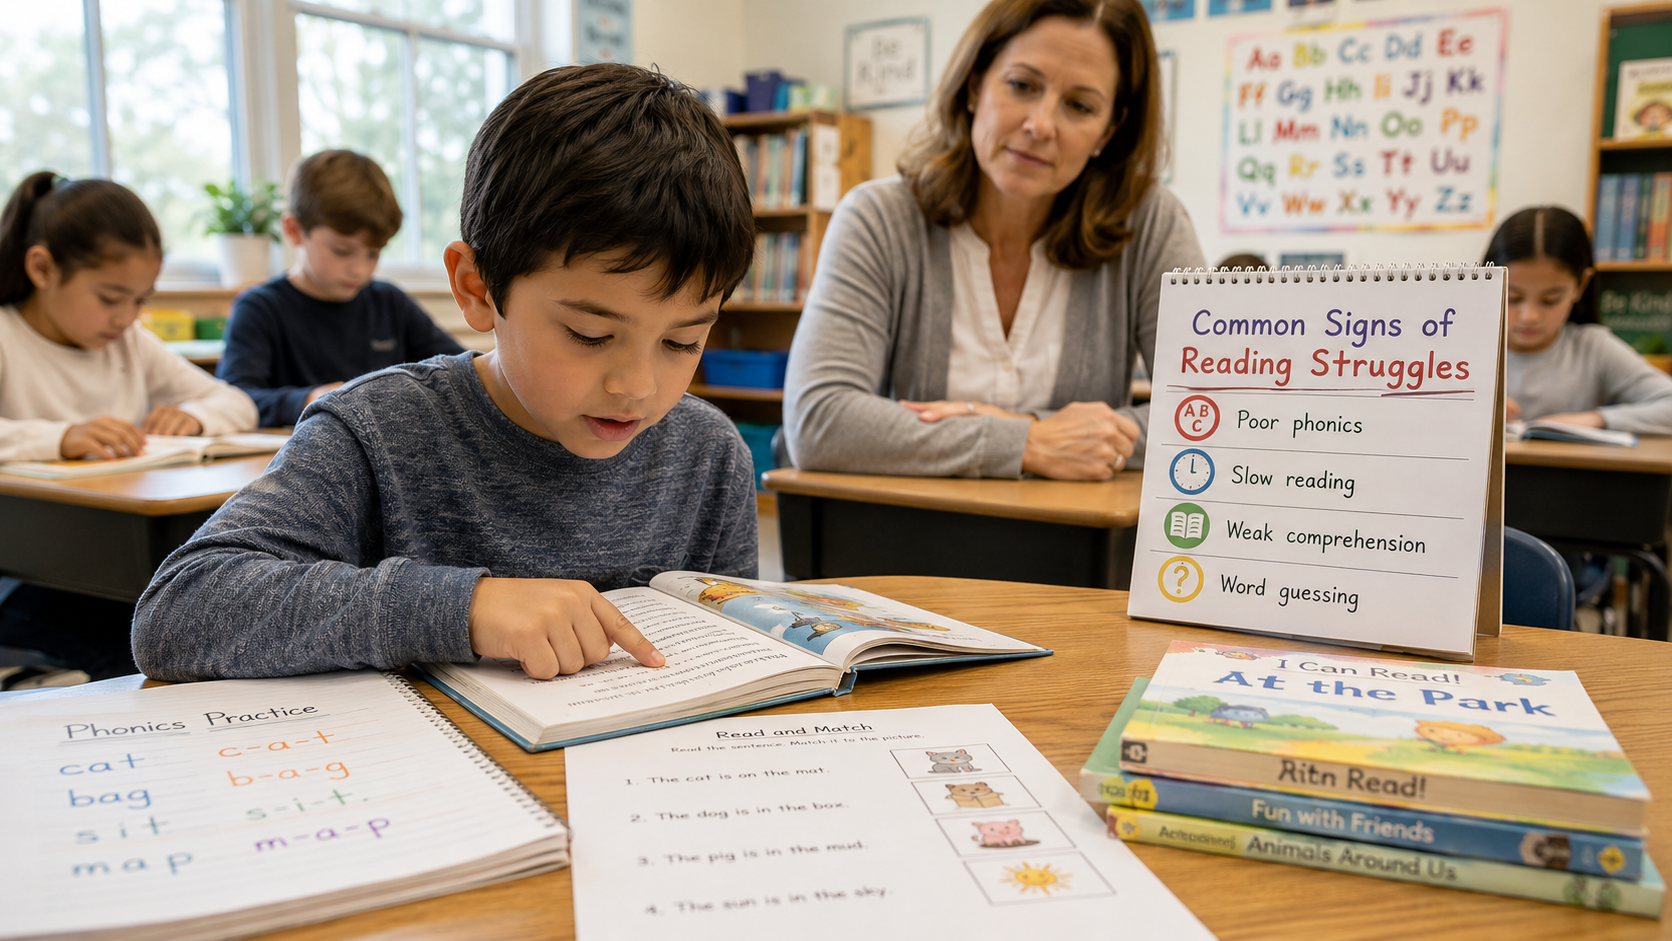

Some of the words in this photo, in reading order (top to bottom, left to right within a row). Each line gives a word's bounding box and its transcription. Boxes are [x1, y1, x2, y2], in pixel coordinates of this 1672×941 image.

[1338, 37, 1371, 64] Cc
[1385, 34, 1423, 61] Dd
[1437, 28, 1474, 57] Ee
[1277, 81, 1313, 114] Gg
[1403, 71, 1433, 105] Jj
[1447, 67, 1483, 95] Kk
[1273, 119, 1320, 146] Mm
[1331, 116, 1368, 140] Nn
[1381, 110, 1423, 138] Oo
[1441, 107, 1478, 141] Pp
[1237, 156, 1276, 187] Qq
[1333, 152, 1365, 177] Ss
[1431, 150, 1469, 174] Uu
[1237, 193, 1271, 217] Vv
[1387, 188, 1420, 221] Yy
[1436, 187, 1471, 213] Zz
[1192, 309, 1305, 336] Common
[1325, 308, 1402, 348] Signs
[1422, 308, 1456, 337] of
[1181, 346, 1292, 387] Reading
[1310, 348, 1470, 390] Struggles
[1237, 410, 1279, 430] Poor
[1293, 412, 1363, 438] phonics
[1231, 465, 1273, 485] Slow
[1286, 470, 1355, 498] reading
[1227, 520, 1273, 541] Weak
[1286, 529, 1426, 553] comprehension
[1221, 574, 1266, 596] Word
[1279, 586, 1359, 613] guessing
[1277, 659, 1288, 669] I
[1299, 661, 1357, 675] Can
[1370, 667, 1460, 684] Read!
[1213, 671, 1287, 690] At
[1307, 680, 1396, 700] the
[1419, 689, 1556, 717] Park
[64, 722, 186, 739] Phonics
[203, 705, 318, 726] Practice
[715, 730, 764, 738] Read
[773, 727, 807, 735] and
[814, 723, 873, 733] Match
[218, 730, 334, 757] c-a-t
[59, 753, 145, 775] cat
[227, 762, 350, 787] b-a-g
[686, 774, 712, 782] cat
[762, 769, 791, 777] the
[795, 767, 831, 775] mat.
[68, 789, 151, 809] bag
[1347, 768, 1427, 799] Read!
[655, 812, 690, 821] The
[697, 810, 729, 819] dog
[735, 807, 750, 816] is
[756, 806, 771, 814] in
[812, 801, 849, 810] box.
[1252, 798, 1291, 822] Fun
[1297, 808, 1345, 831] with
[1351, 812, 1435, 844] Friends
[74, 816, 169, 844] sit
[253, 818, 390, 851] m-a-p
[72, 852, 193, 877] map
[663, 853, 701, 864] The
[708, 851, 736, 864] pig
[742, 849, 758, 859] is
[765, 847, 782, 856] in
[789, 844, 820, 854] the
[1246, 834, 1331, 863] Animals
[1337, 846, 1420, 876] Around
[1427, 859, 1457, 881] Us
[673, 901, 714, 912] The
[721, 898, 757, 909] sun
[763, 895, 781, 906] is
[787, 893, 807, 903] in
[813, 888, 847, 901] the
